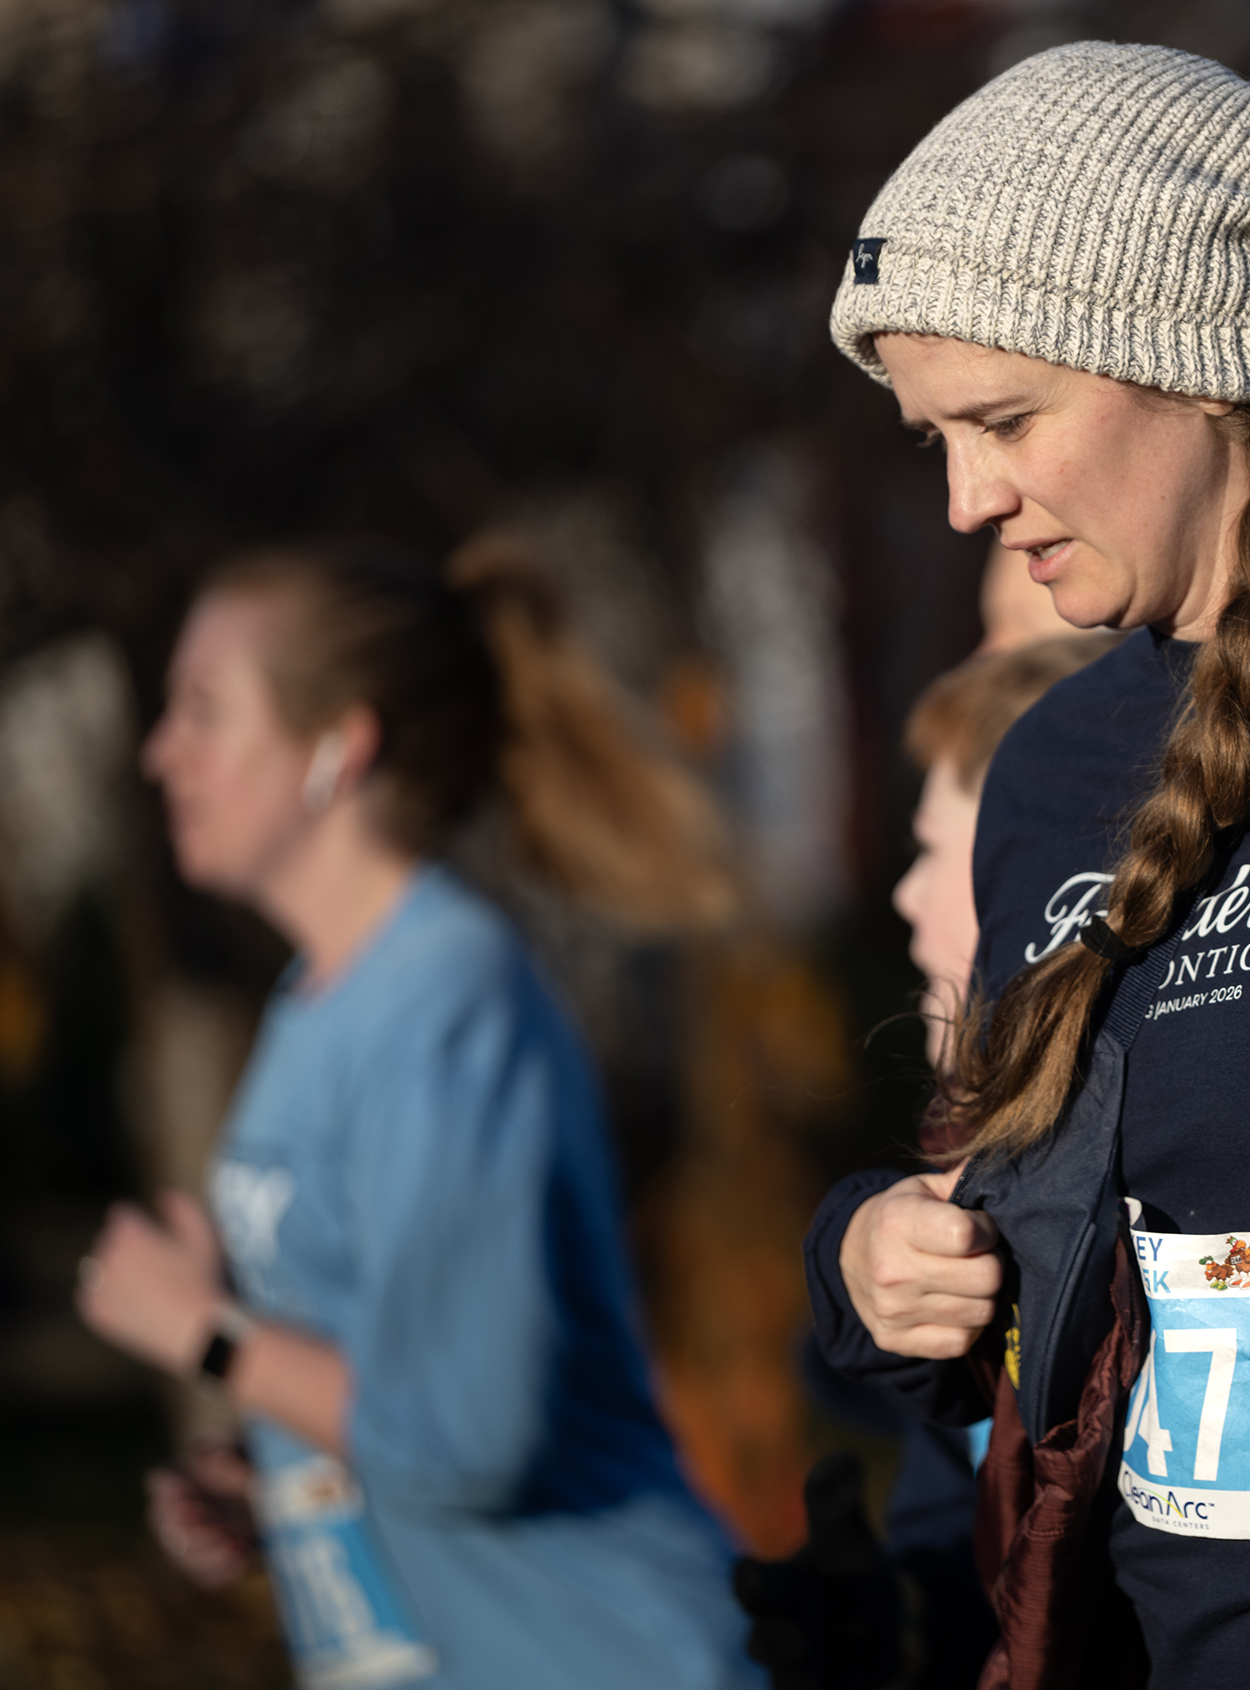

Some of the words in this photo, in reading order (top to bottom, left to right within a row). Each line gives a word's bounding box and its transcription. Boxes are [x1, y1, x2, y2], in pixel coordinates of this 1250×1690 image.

[1153, 992, 1209, 1020] JANUARY
[1208, 984, 1243, 1004] 2026
[1131, 1234, 1163, 1262] EY
[1172, 1520, 1210, 1531] CENTERS
